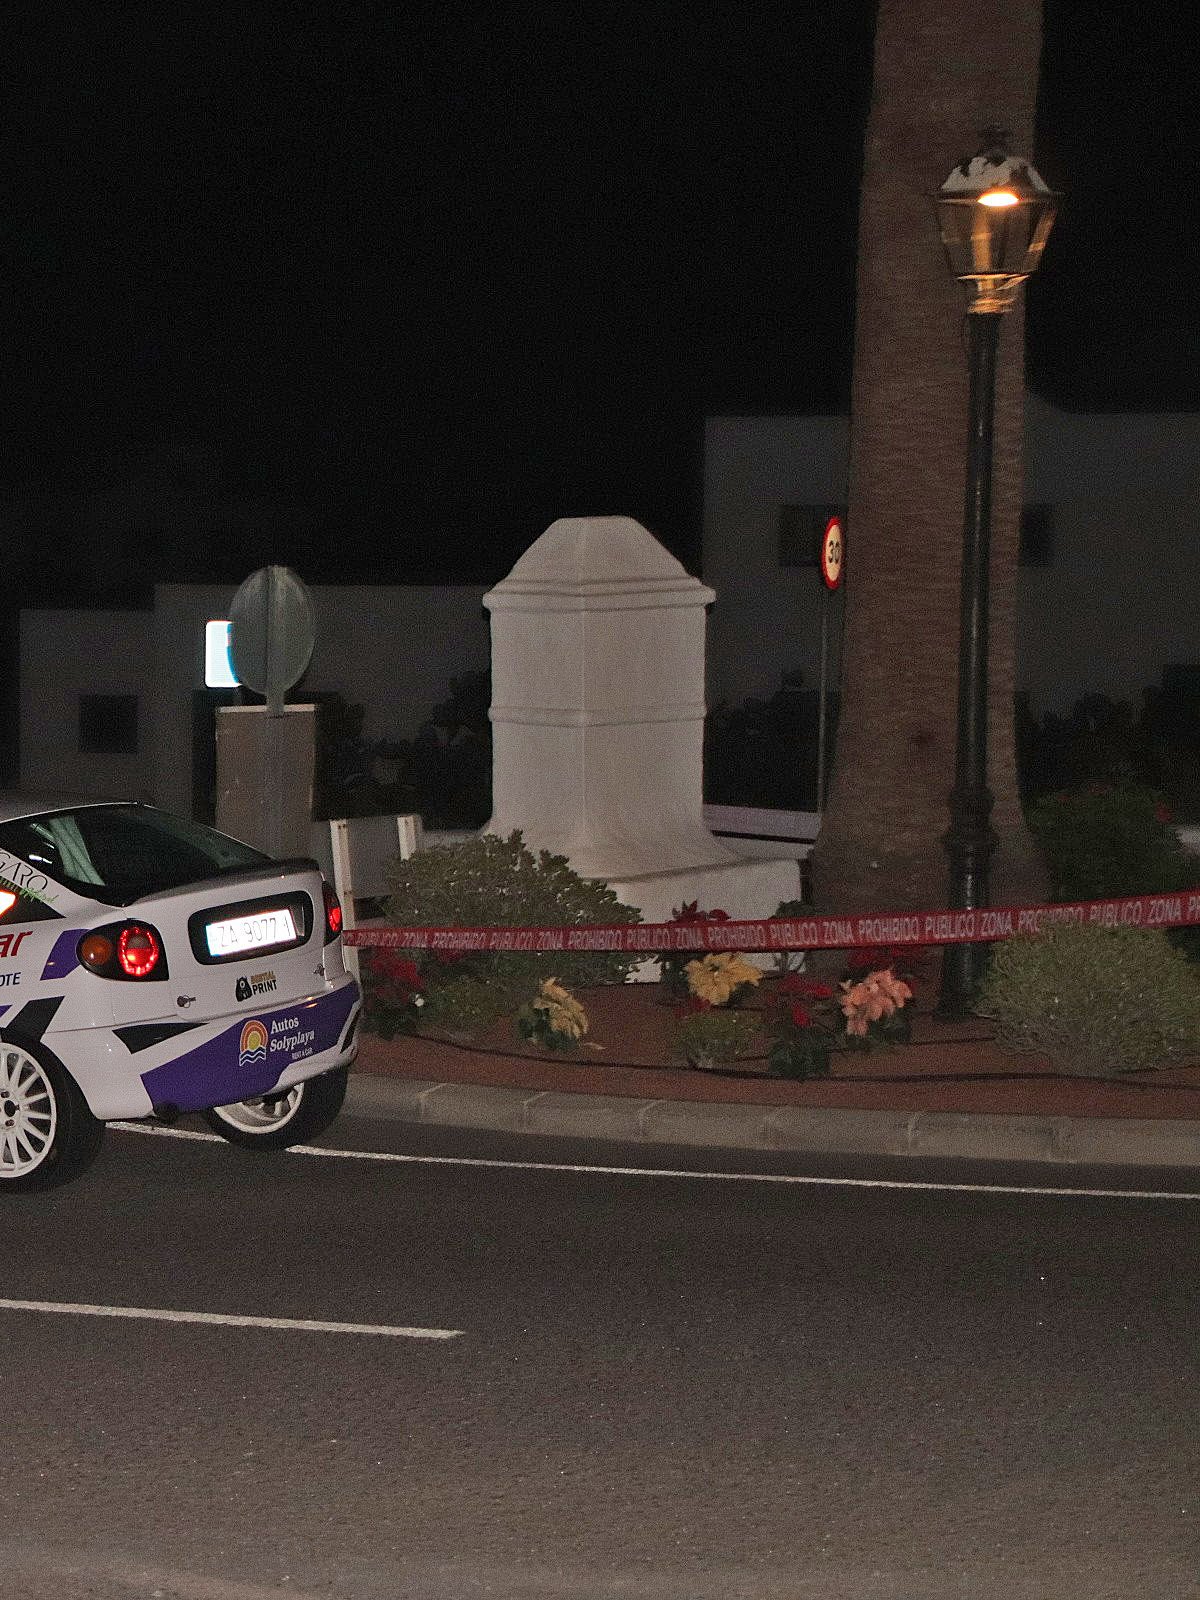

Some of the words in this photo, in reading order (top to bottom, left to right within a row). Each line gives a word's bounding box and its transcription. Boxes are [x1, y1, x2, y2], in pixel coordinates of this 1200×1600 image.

[244, 917, 276, 942] 9077
[770, 922, 818, 945] PUBLICO
[823, 920, 855, 943] ZONA
[859, 916, 919, 941] PROHIBIDO
[925, 913, 975, 938] PUBLICO
[981, 911, 1014, 936] ZONA
[1146, 898, 1181, 923] ZONA
[252, 979, 277, 995] PRINT
[270, 1017, 299, 1034] Autos
[269, 1030, 315, 1052] Solyplaya
